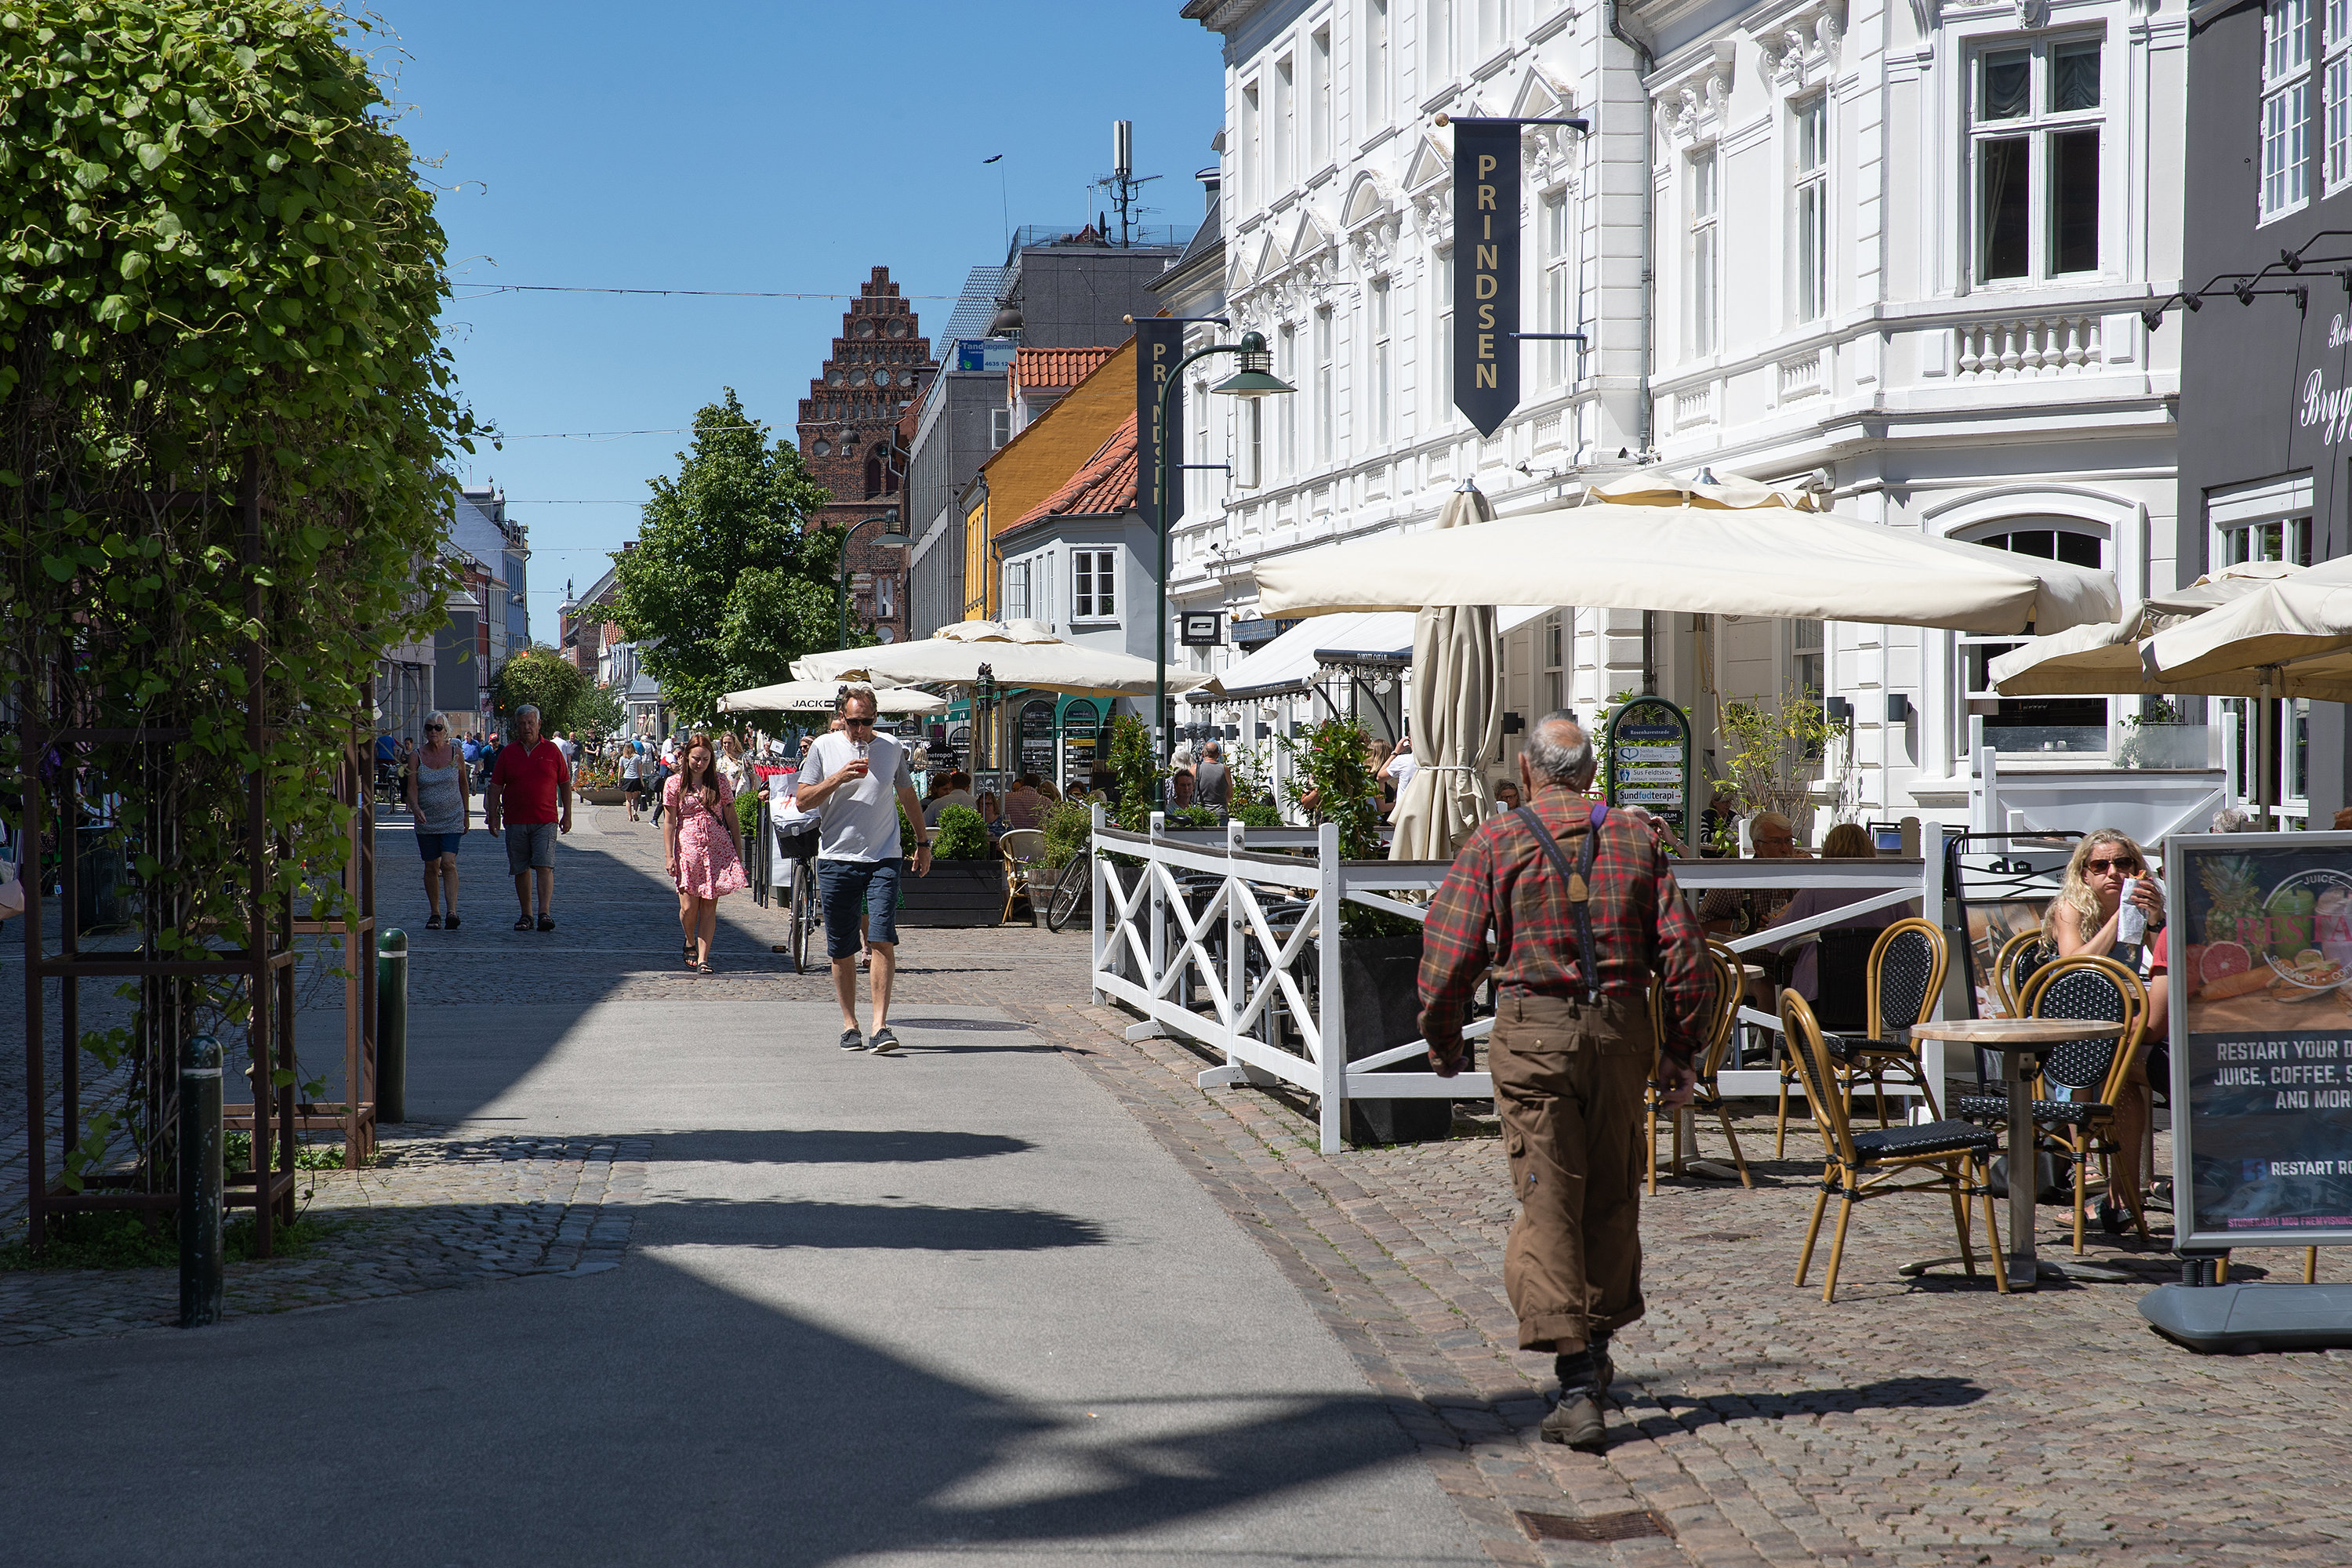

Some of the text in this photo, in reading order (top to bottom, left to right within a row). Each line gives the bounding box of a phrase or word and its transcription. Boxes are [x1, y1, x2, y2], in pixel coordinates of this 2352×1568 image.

[1475, 154, 1499, 389] PRINDSEN
[961, 342, 1014, 352] Tandlægerne
[792, 699, 823, 708] JACK
[2303, 874, 2337, 885] JUICE
[2270, 955, 2318, 983] SANDWICH
[2217, 1041, 2288, 1061] RESTART
[2292, 1040, 2339, 1058] YOUR
[2213, 1067, 2267, 1087] JUICE,
[2270, 1065, 2341, 1085] COFFEE,
[2275, 1089, 2352, 1109] AND MOR
[2270, 1160, 2334, 1176] RESTART
